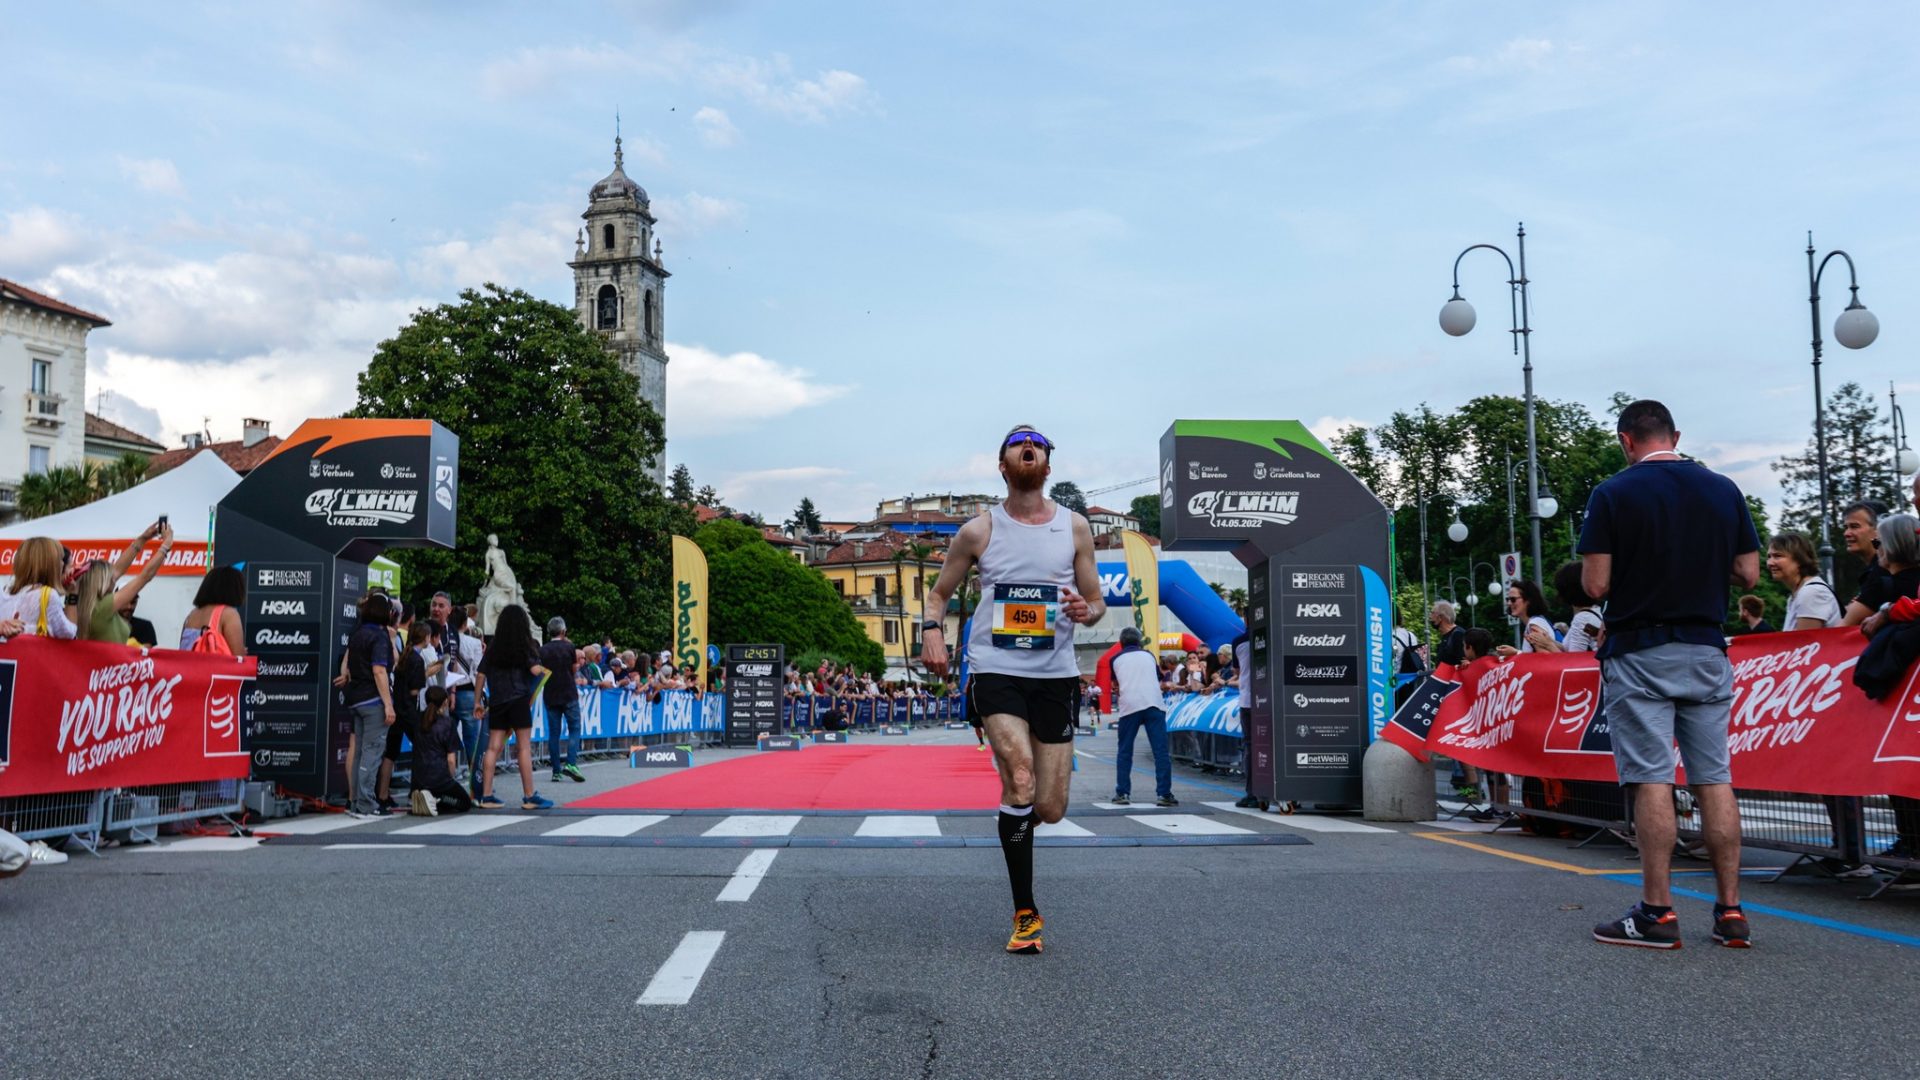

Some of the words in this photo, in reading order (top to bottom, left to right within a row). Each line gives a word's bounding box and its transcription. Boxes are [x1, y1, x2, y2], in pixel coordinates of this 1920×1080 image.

[340, 494, 418, 513] LMHM
[1222, 496, 1299, 514] LMHM
[332, 518, 380, 526] 14.05.2022
[1216, 519, 1262, 528] 14.05.2022
[108, 550, 153, 566] HLF
[275, 571, 312, 579] REGIONE
[1008, 588, 1042, 598] HOKA
[260, 600, 306, 615] HOKA
[1296, 604, 1342, 617] HOKA
[1013, 610, 1036, 624] 459
[256, 628, 310, 644] Ricola
[1370, 606, 1384, 674] FINISH
[88, 657, 155, 693] WHEREVER
[1308, 696, 1350, 704] vcotrasporti
[1484, 672, 1533, 727] RACE
[57, 692, 115, 754] YOU
[116, 674, 182, 732] RACE
[616, 690, 654, 735] HOKA
[662, 692, 693, 732] HOKA
[700, 693, 722, 730] HOKA
[1500, 720, 1515, 744] YOU
[1769, 718, 1816, 748] YOU
[67, 750, 85, 776] WE
[88, 730, 145, 772] SUPPORT
[143, 724, 165, 752] YOU
[646, 752, 677, 762] HOKA
[1308, 754, 1347, 763] netWelink
